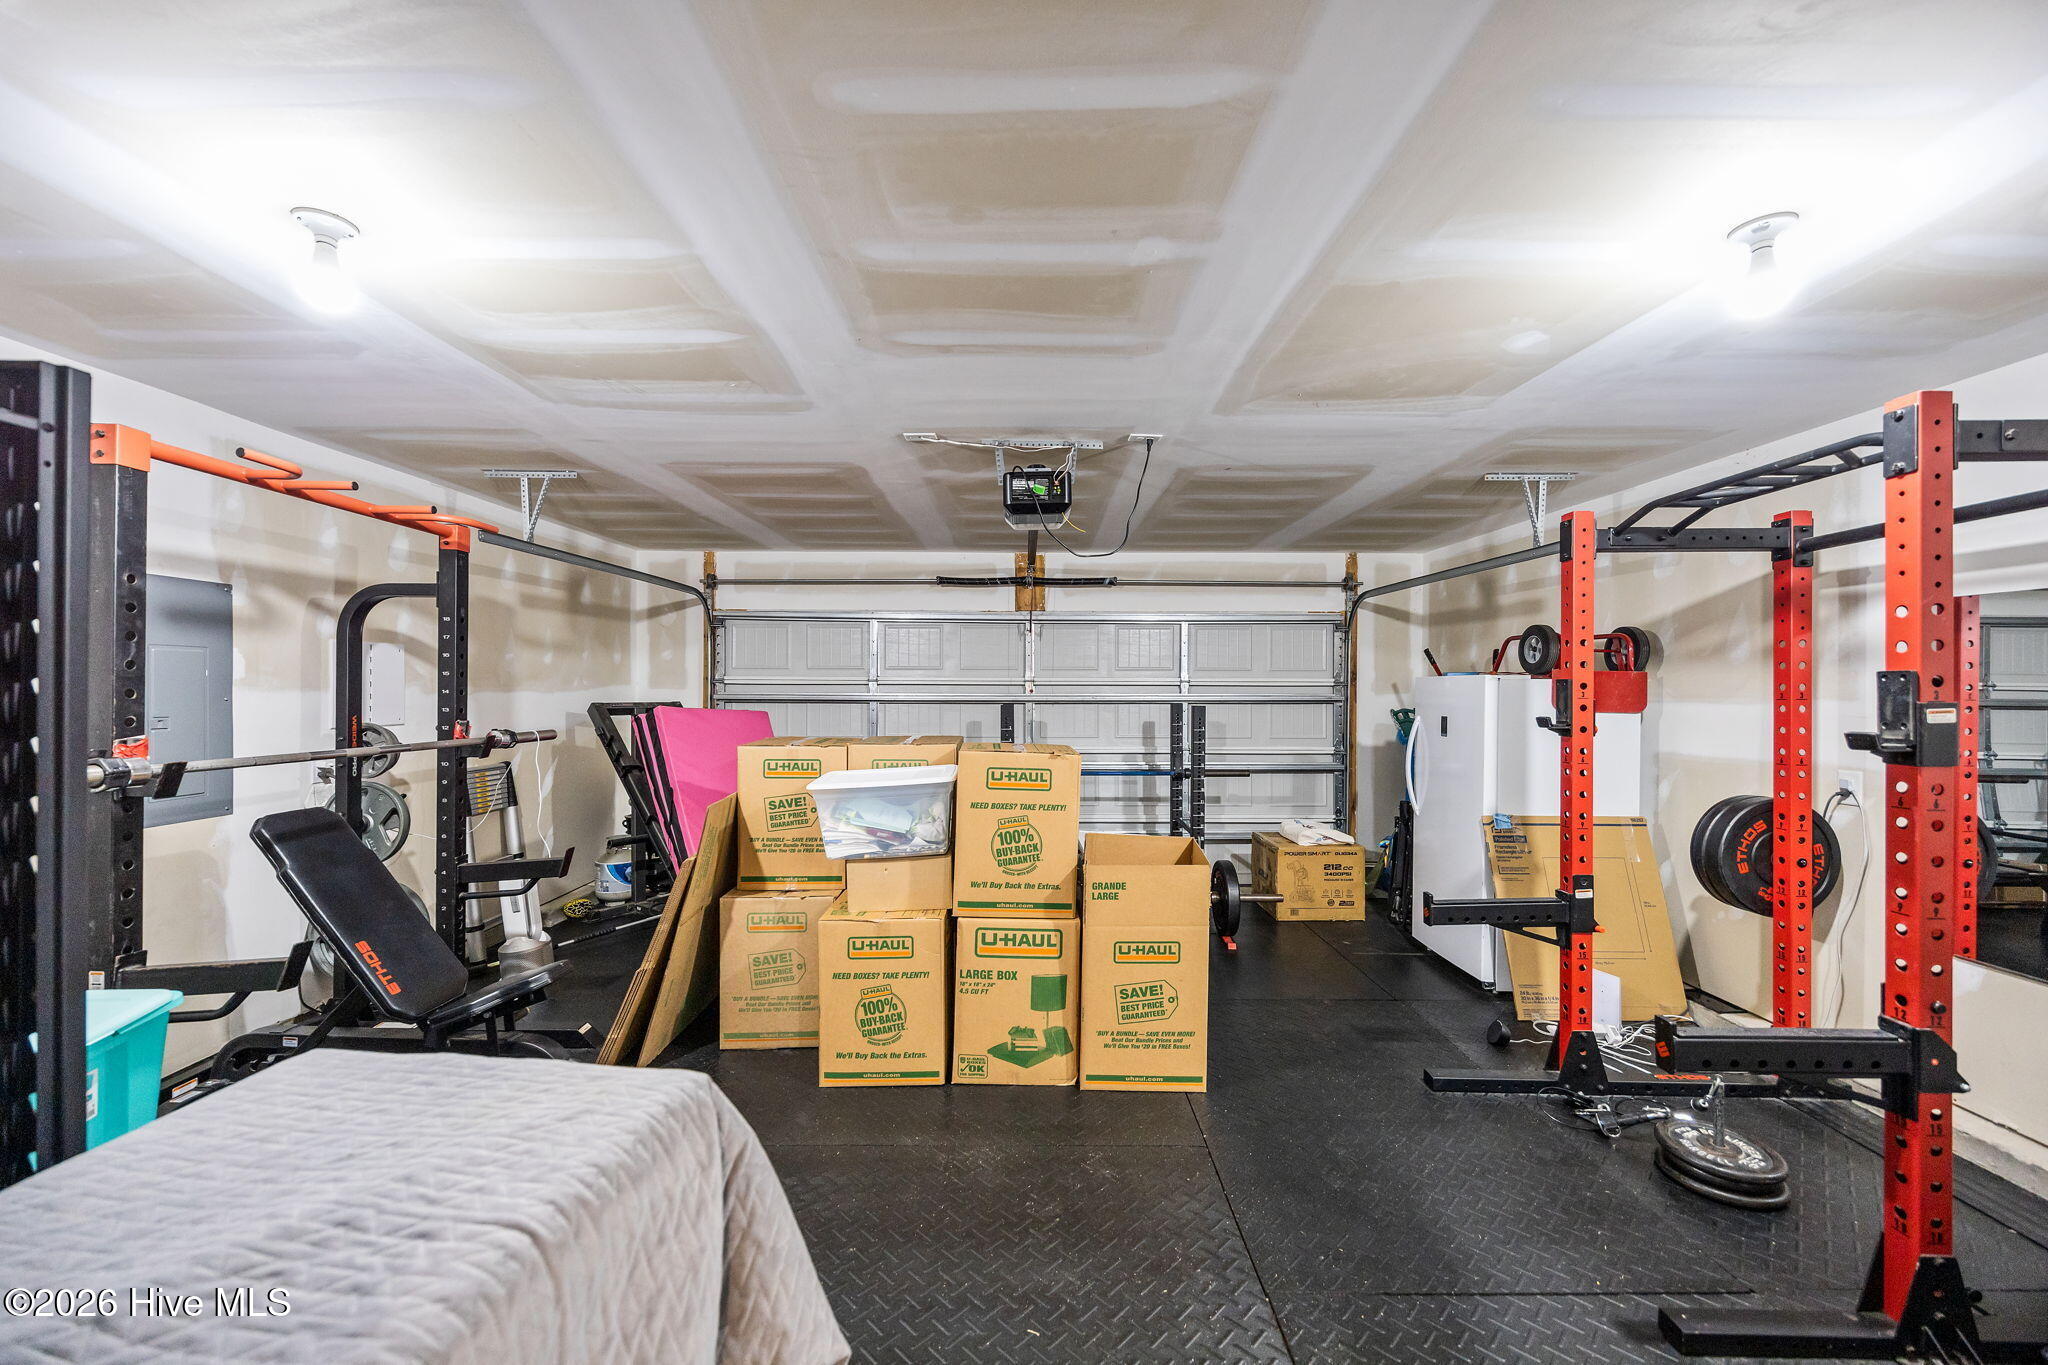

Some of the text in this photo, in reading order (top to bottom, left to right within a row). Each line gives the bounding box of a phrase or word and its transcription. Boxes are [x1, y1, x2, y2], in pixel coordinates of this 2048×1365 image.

[767, 762, 818, 771] U-HAUL
[991, 771, 1048, 783] U-HAUL
[768, 797, 806, 810] SAVE!
[1898, 796, 1904, 807] 6
[1933, 799, 1940, 809] 6
[770, 810, 808, 821] BEST PRICE
[1000, 817, 1027, 826] U-HAUL
[998, 828, 1034, 846] 100%
[996, 842, 1039, 858] BUY-BACK
[1736, 820, 1768, 874] ETHOS
[990, 882, 1002, 890] Buy
[1092, 882, 1126, 890] GRANDE
[1092, 892, 1119, 900] LARGE
[1897, 902, 1903, 912] 9
[751, 916, 804, 925] U-HAUL
[852, 940, 910, 950] U-HAUL
[981, 932, 1057, 948] U-HAUL
[1118, 945, 1176, 956] U-HAUL
[753, 952, 792, 967] SAVE!
[354, 940, 402, 995] ETHOS
[754, 968, 793, 979] BEST PRICE
[960, 969, 1018, 981] LARGE BOX
[862, 986, 890, 996] U-HAUL
[1120, 984, 1164, 1000] SAVE!
[860, 996, 898, 1016] 100%
[1120, 1001, 1164, 1012] BEST PRICE
[1894, 1006, 1907, 1020] 12
[860, 1012, 904, 1028] BUY-BACK
[1930, 1016, 1942, 1026] 12
[855, 1052, 868, 1060] Buy
[968, 1064, 985, 1072] OK
[1930, 1124, 1942, 1136] 15
